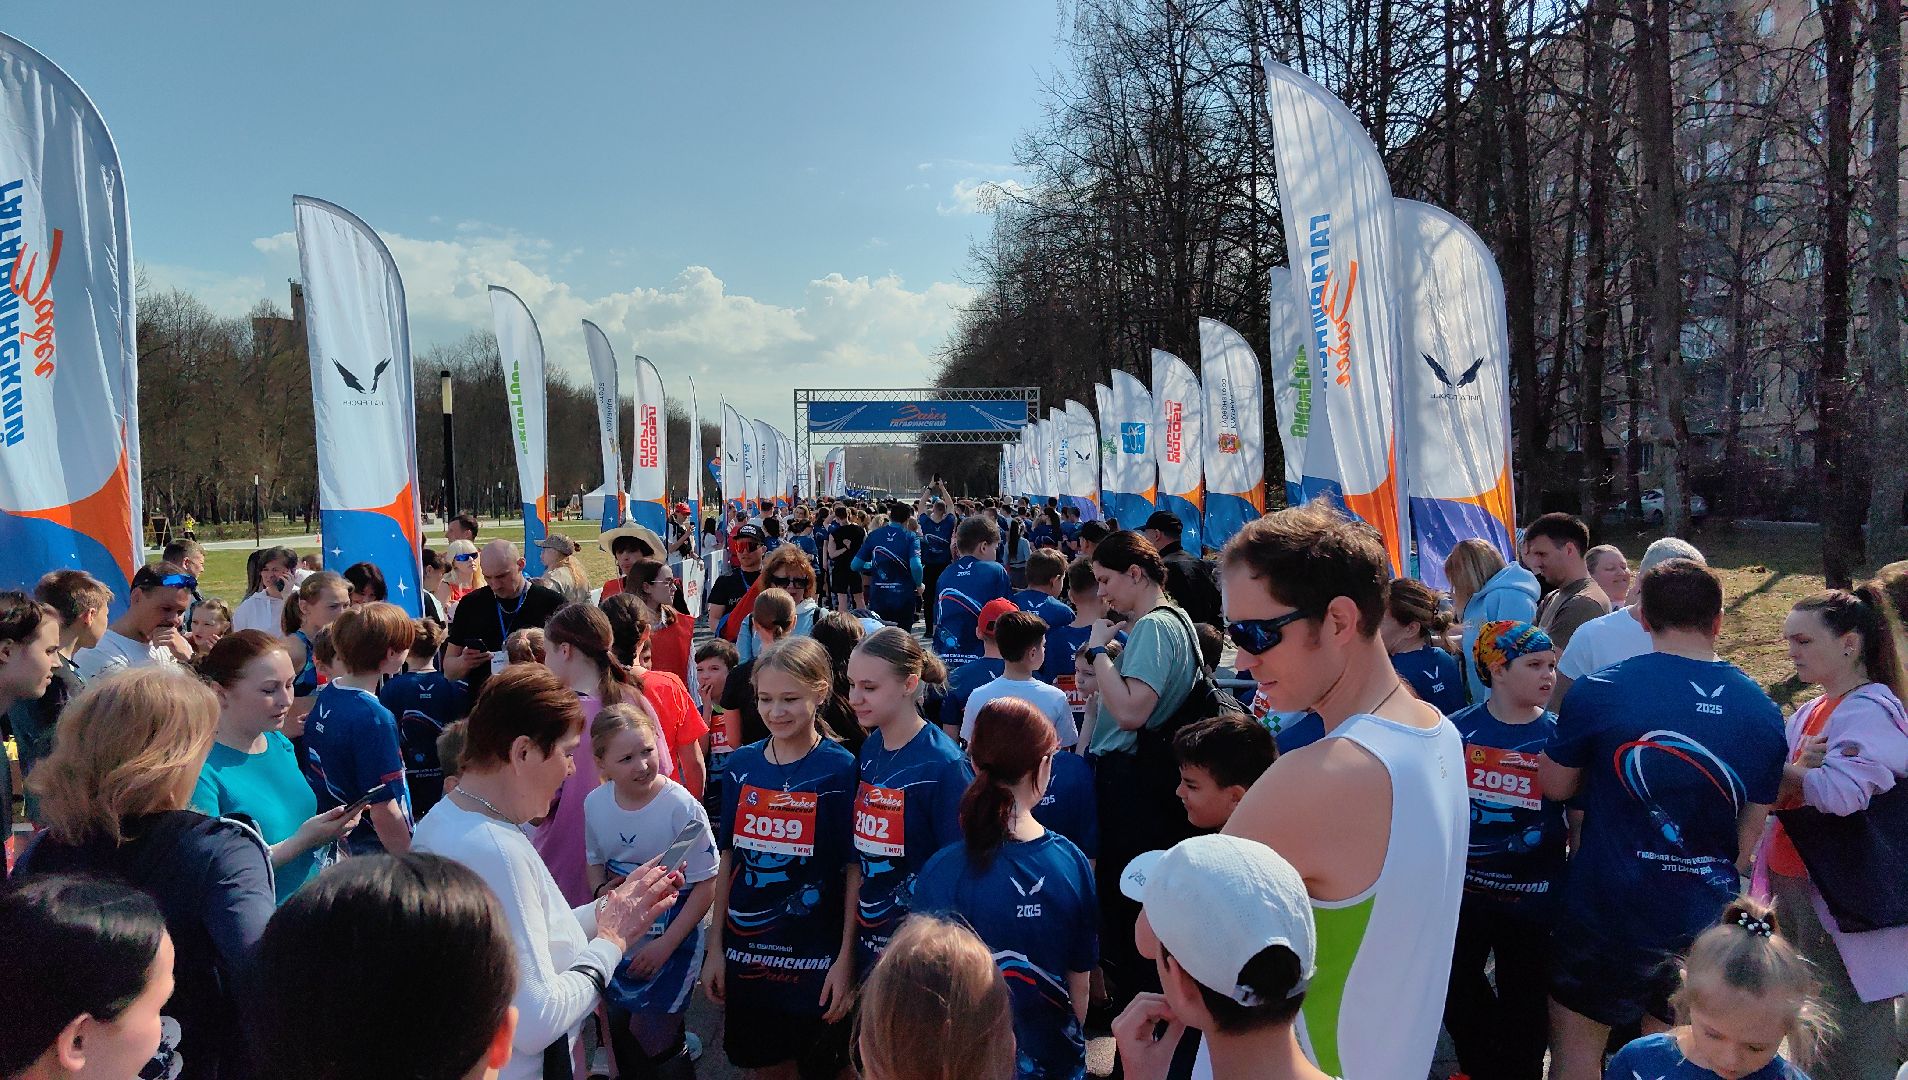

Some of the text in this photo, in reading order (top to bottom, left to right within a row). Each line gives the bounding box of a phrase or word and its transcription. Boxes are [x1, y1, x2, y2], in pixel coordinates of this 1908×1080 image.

[1695, 702, 1723, 715] 2025
[1472, 768, 1531, 795] 2093
[768, 792, 816, 808] Забег
[743, 813, 803, 840] 2039
[855, 810, 890, 839] 2102
[1662, 863, 1678, 872] ЭТО
[725, 947, 832, 970] ГАГАРИНСКИЙ
